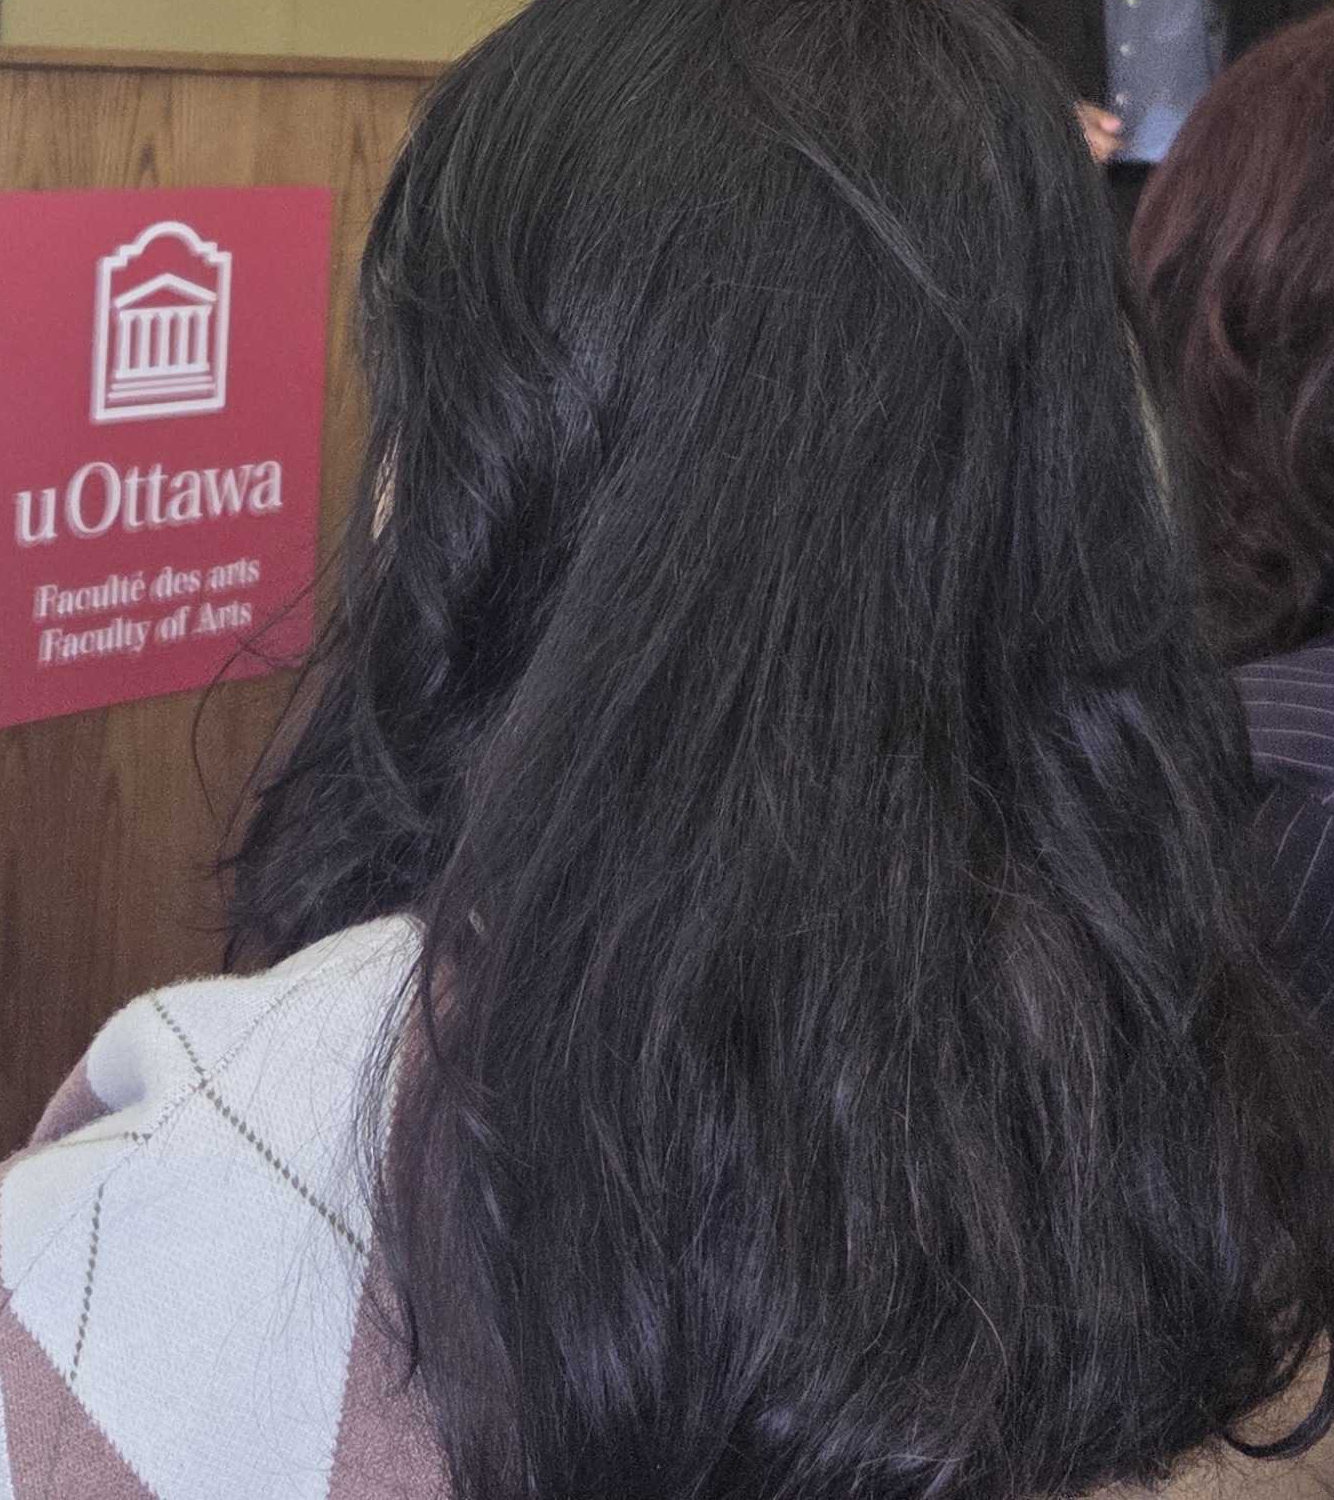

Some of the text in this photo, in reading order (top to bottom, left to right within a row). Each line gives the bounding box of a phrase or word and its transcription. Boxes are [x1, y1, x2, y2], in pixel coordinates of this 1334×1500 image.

[15, 459, 283, 546] uOttawa
[35, 556, 261, 620] Faculté des arts
[39, 599, 255, 666] Faculty of Arts
